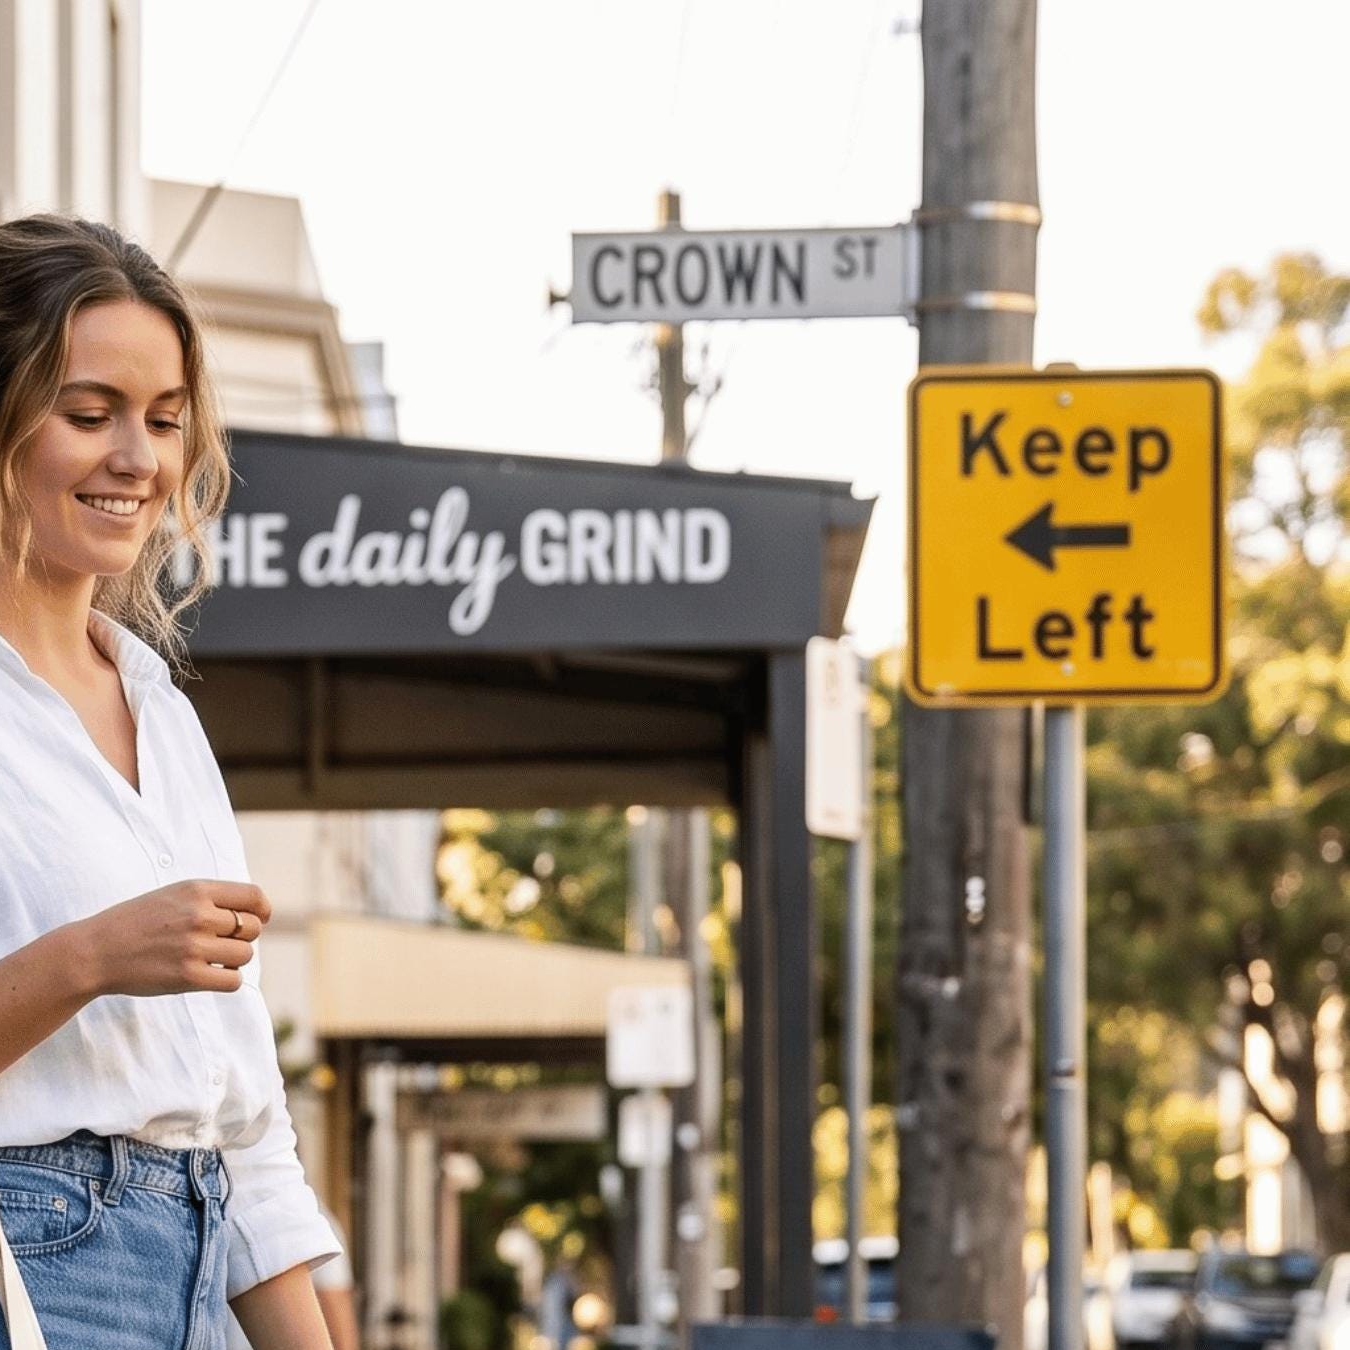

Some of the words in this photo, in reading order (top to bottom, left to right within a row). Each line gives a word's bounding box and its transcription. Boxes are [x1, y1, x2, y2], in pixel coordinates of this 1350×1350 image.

[589, 242, 807, 309] CROWN
[833, 235, 879, 280] ST
[960, 411, 1172, 494] Keep
[297, 485, 517, 636] daily
[520, 507, 732, 585] GRIND
[976, 592, 1156, 662] Left
